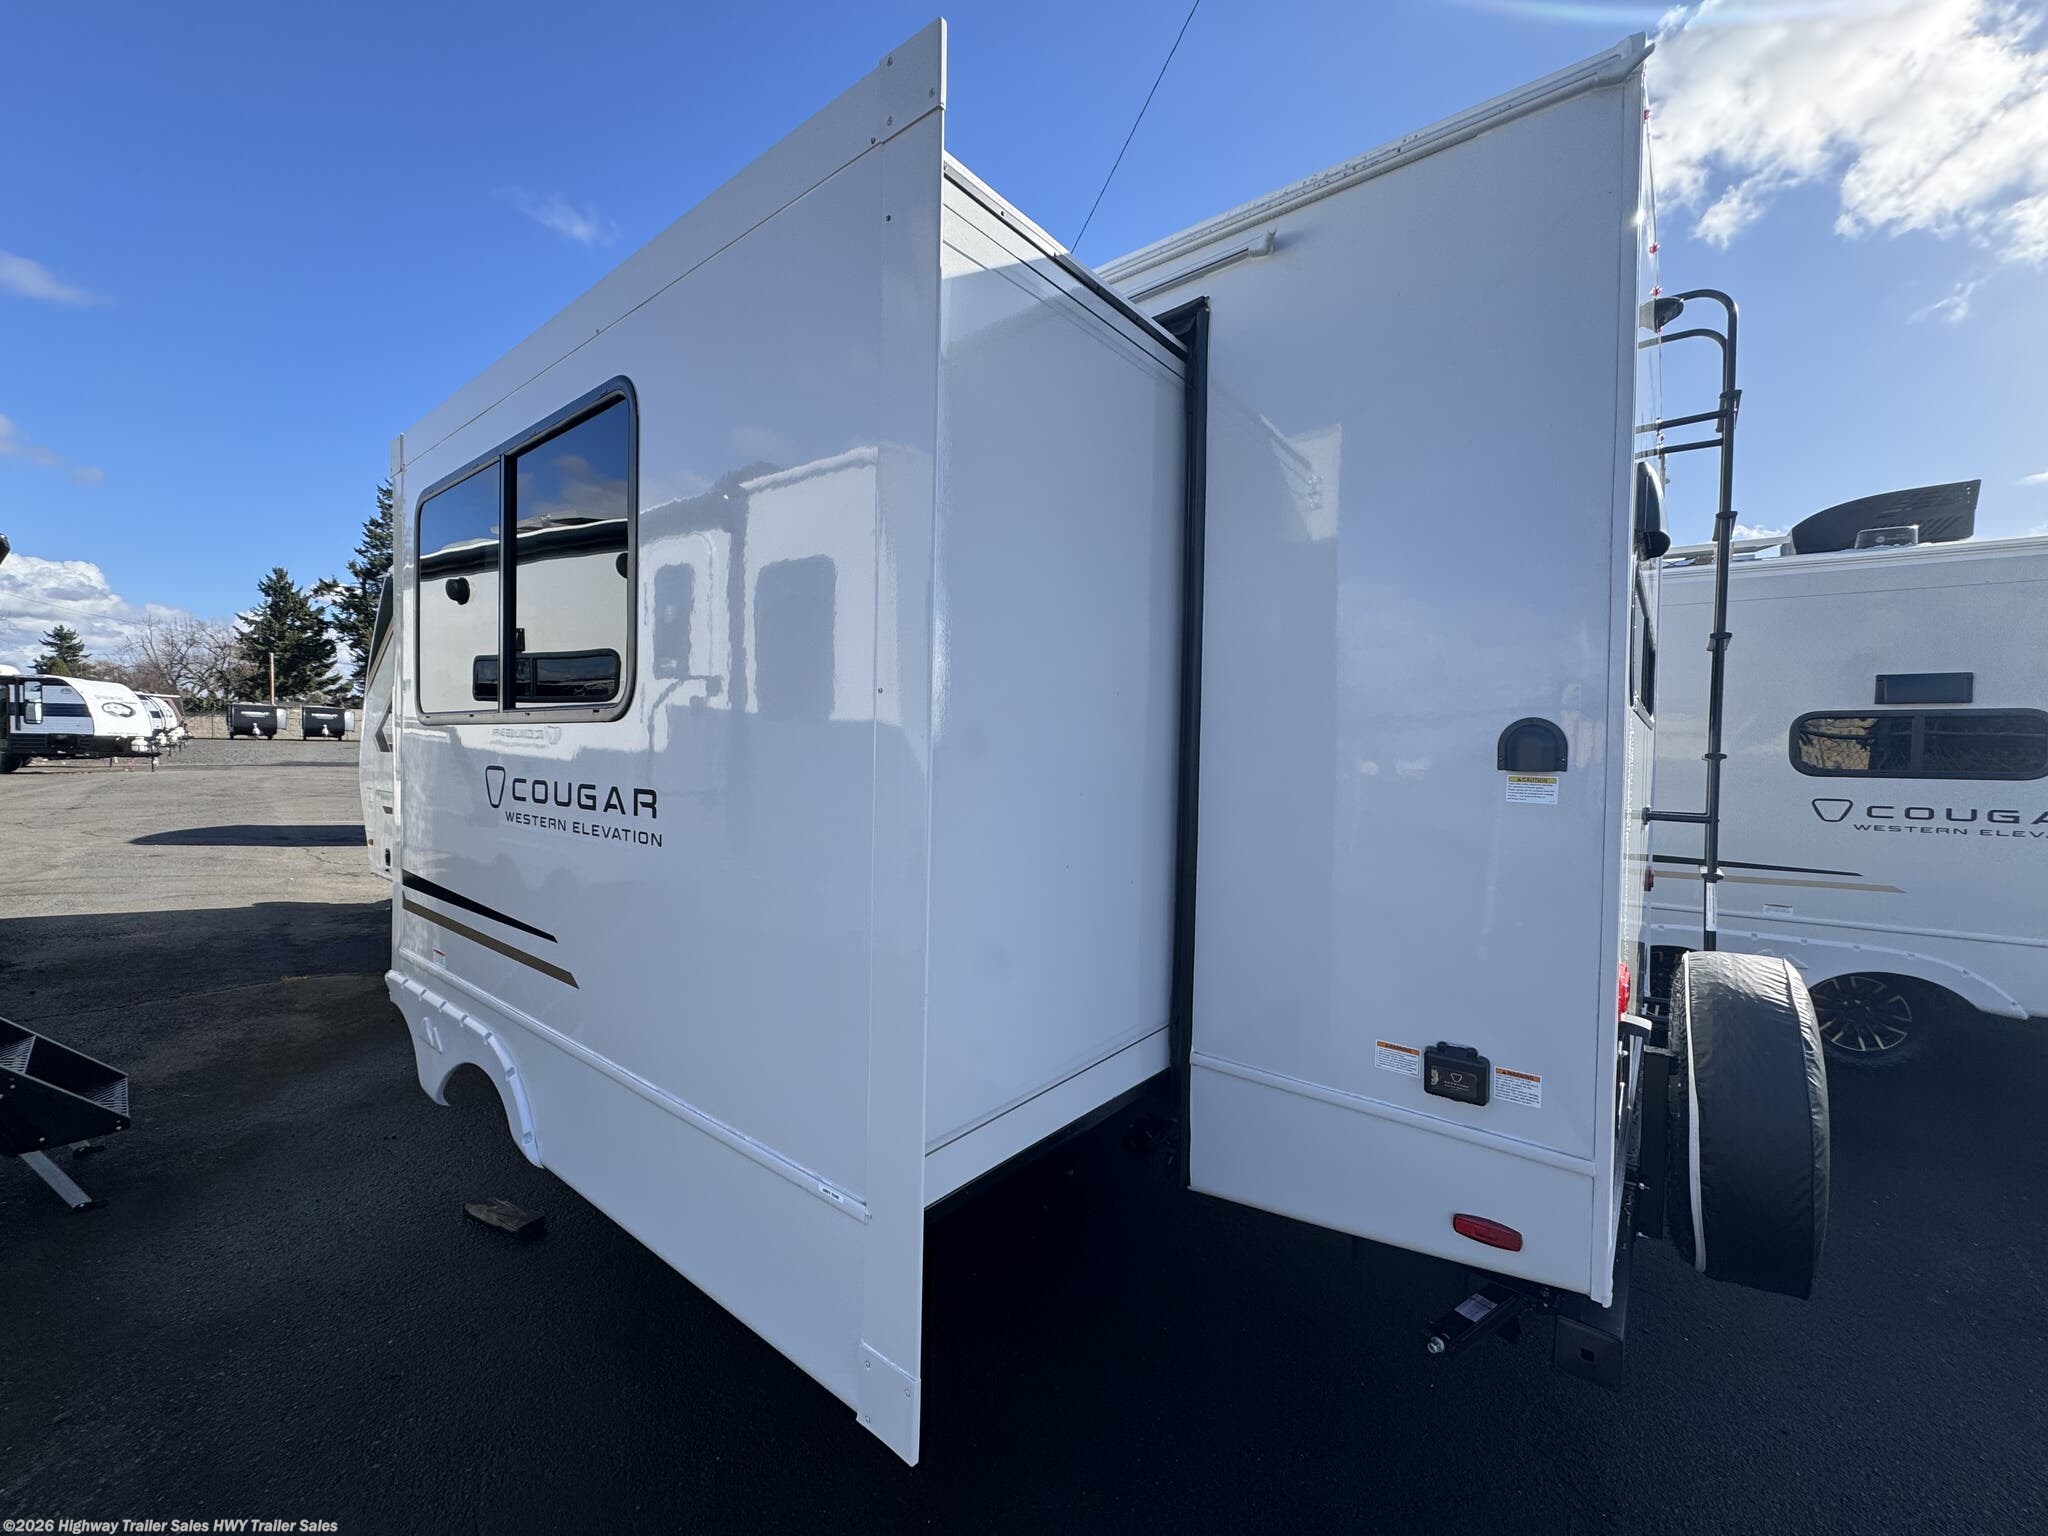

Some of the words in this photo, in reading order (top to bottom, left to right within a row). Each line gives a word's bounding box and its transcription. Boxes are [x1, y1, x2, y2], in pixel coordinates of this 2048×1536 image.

[512, 777, 657, 819] COUGAR
[505, 811, 567, 832] WESTERN
[572, 821, 663, 848] ELEVATION
[1853, 824, 1968, 835] WESTERN
[1979, 829, 2048, 839] ELEV
